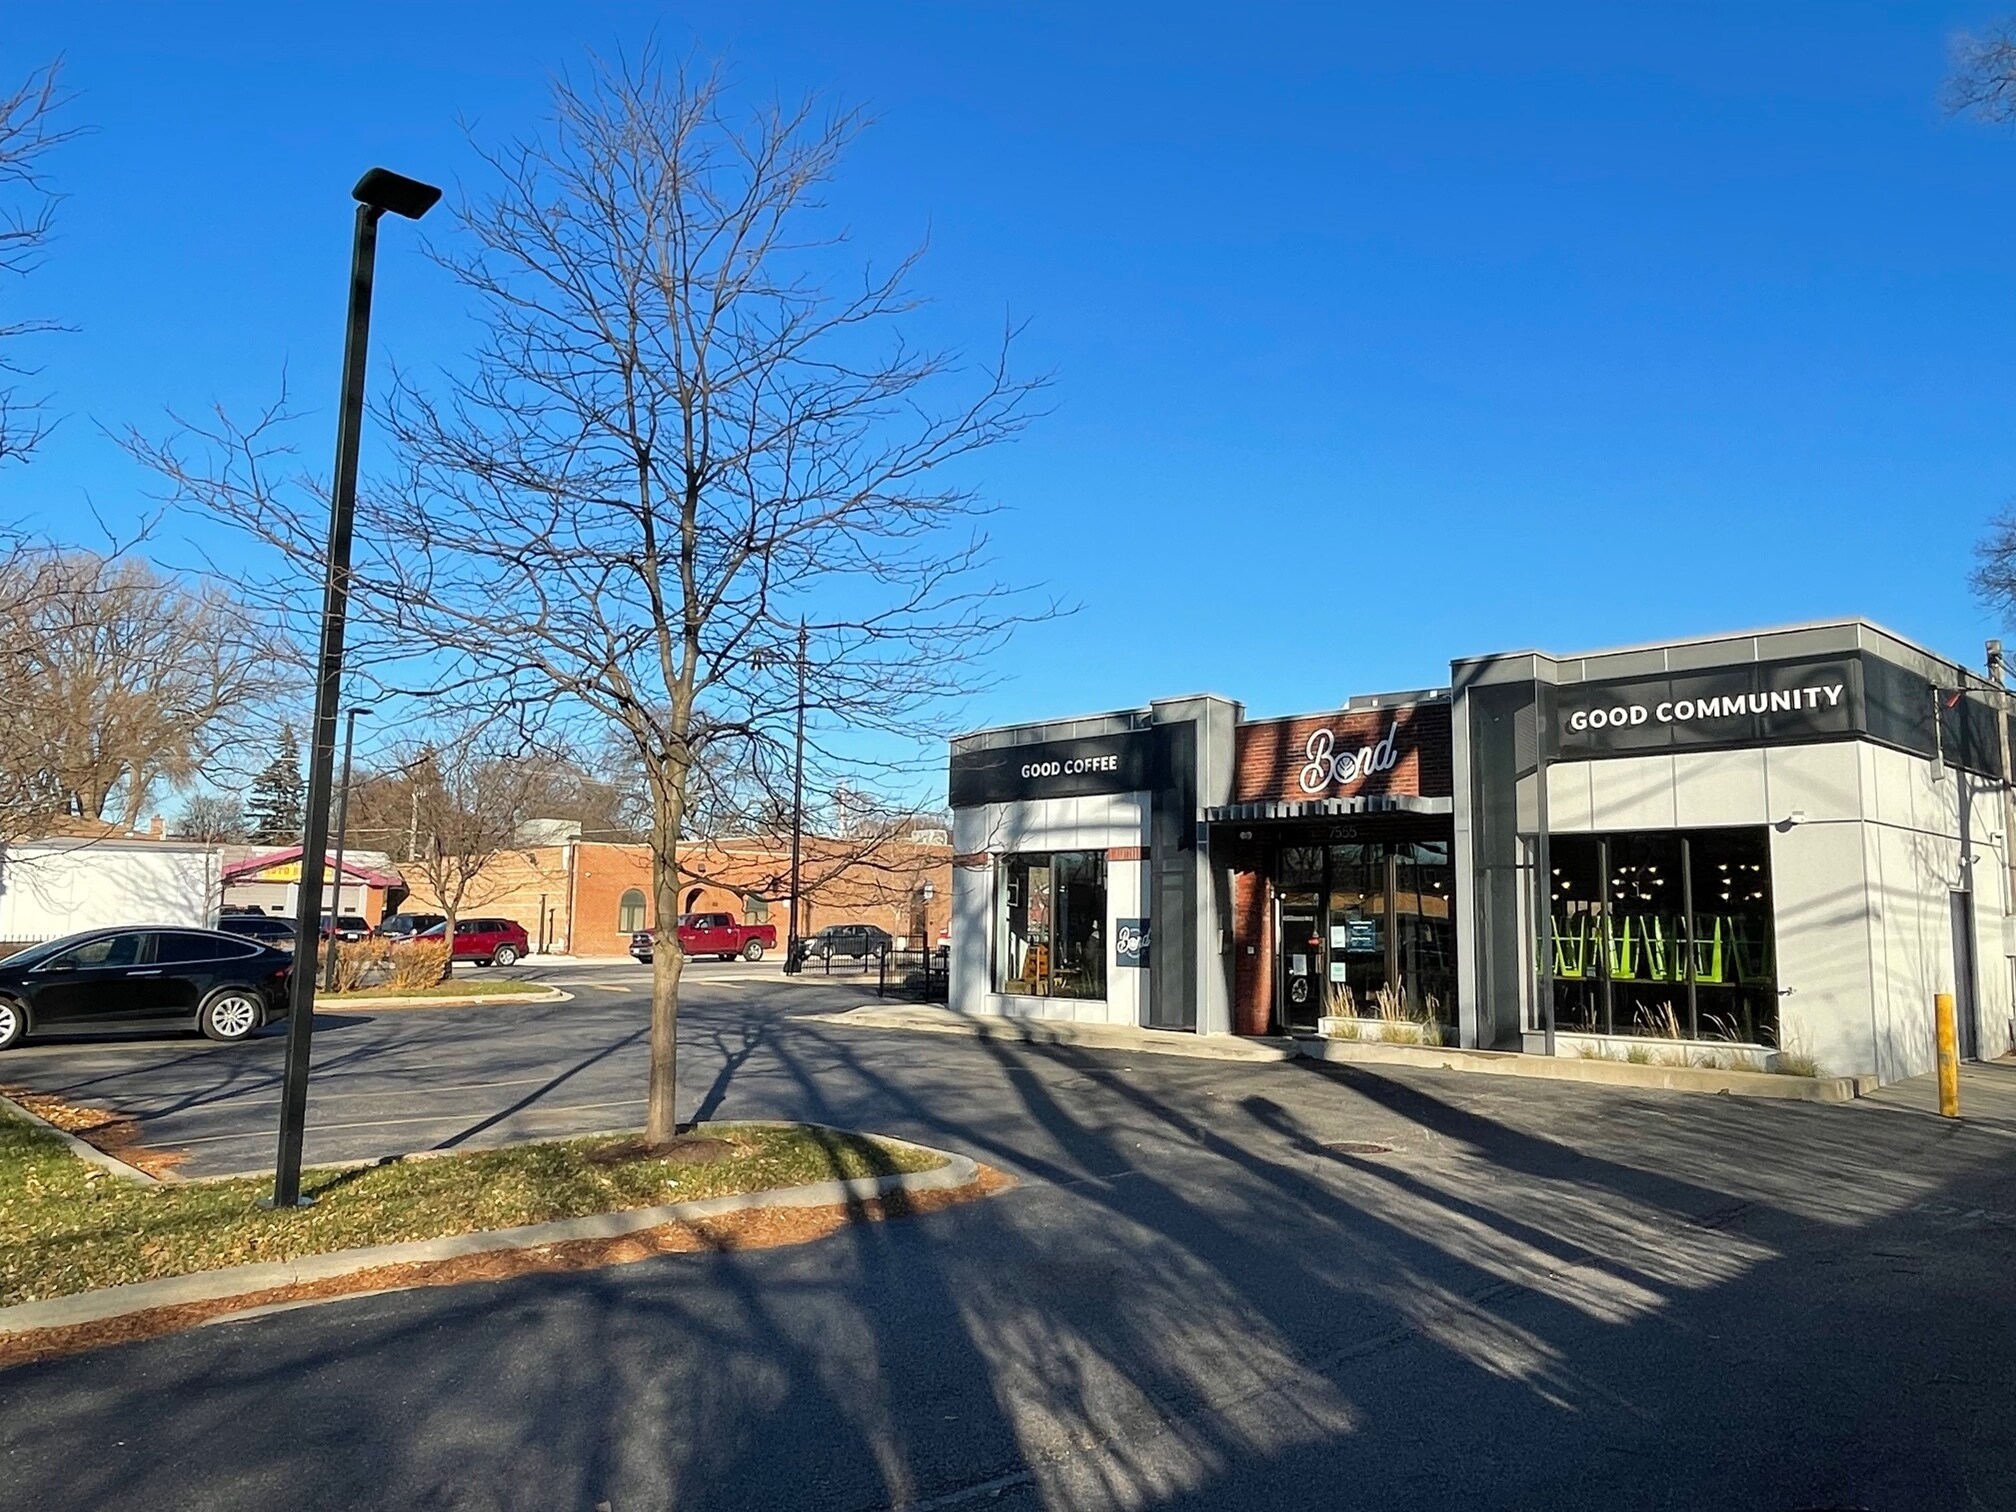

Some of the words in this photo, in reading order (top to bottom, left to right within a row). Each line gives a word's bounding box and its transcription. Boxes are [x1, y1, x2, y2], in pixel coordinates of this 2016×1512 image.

[1570, 704, 1648, 731] GOOD
[1655, 684, 1844, 723] COMMUNITY
[1021, 760, 1061, 779] GOOD
[1064, 755, 1118, 775] COFFEE
[1299, 720, 1399, 794] Bond
[1328, 825, 1358, 839] 7555
